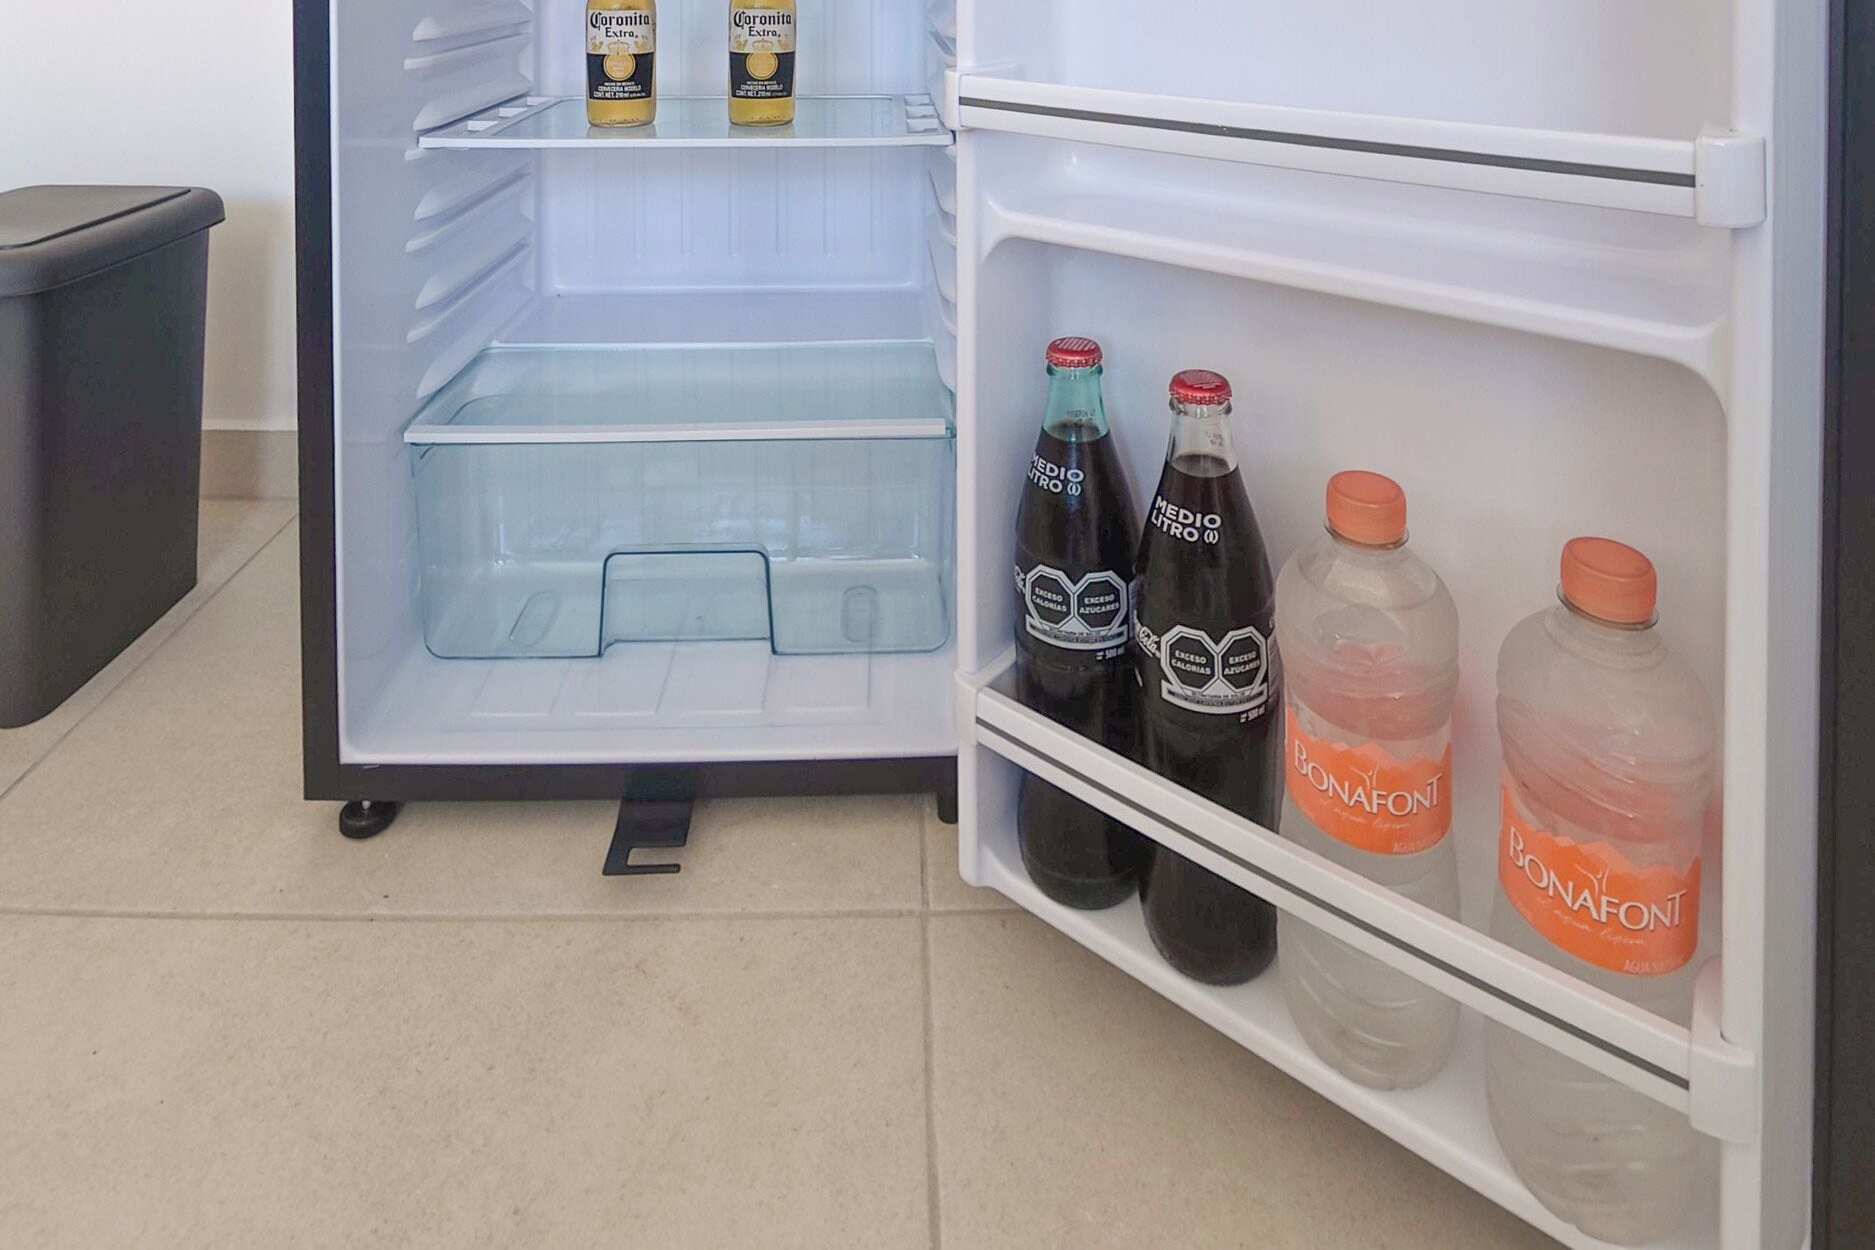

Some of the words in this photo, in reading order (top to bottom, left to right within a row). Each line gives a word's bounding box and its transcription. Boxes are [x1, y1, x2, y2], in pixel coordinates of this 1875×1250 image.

[590, 12, 650, 30] Coronita
[733, 10, 792, 29] Coronita
[1031, 452, 1084, 483] MEDIO
[1155, 495, 1222, 529] MEDIO
[1151, 509, 1199, 542] LITRO
[1035, 587, 1063, 602] EXCESO
[1084, 594, 1115, 605] EXCESO
[1175, 650, 1207, 664] EXCESO
[1294, 739, 1442, 816] BONAFONT
[1509, 826, 1687, 931] BONAFONT
